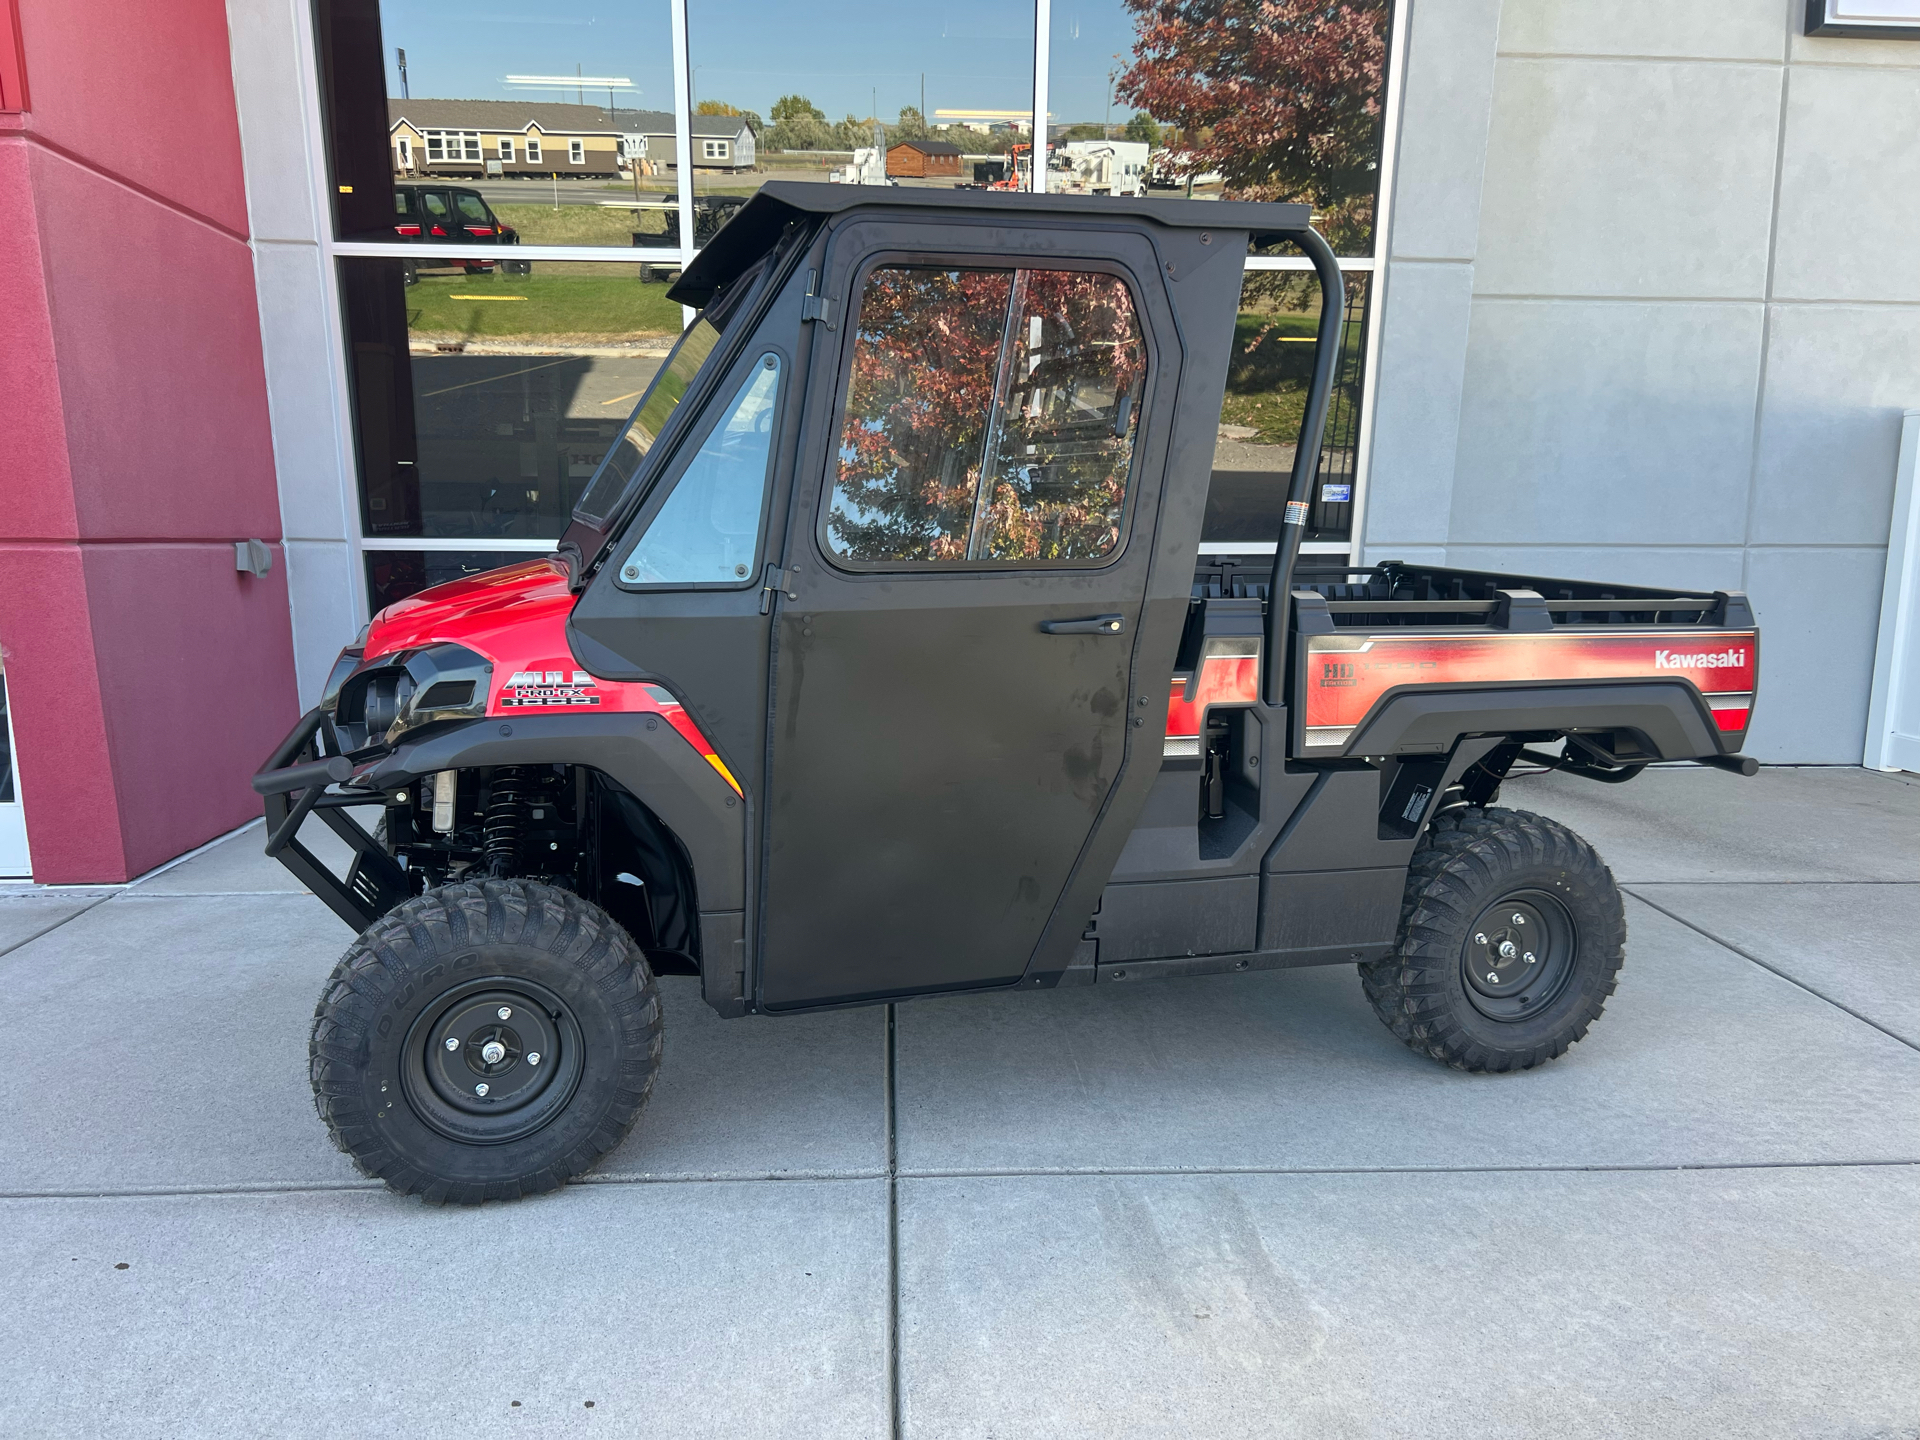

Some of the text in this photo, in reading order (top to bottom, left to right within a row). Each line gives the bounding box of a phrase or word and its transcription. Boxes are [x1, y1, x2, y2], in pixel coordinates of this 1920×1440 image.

[1655, 649, 1745, 669] Kawasaki
[503, 670, 597, 689] MULE
[1324, 663, 1354, 678] HD
[511, 698, 591, 706] 1000
[374, 951, 479, 1041] DURO
